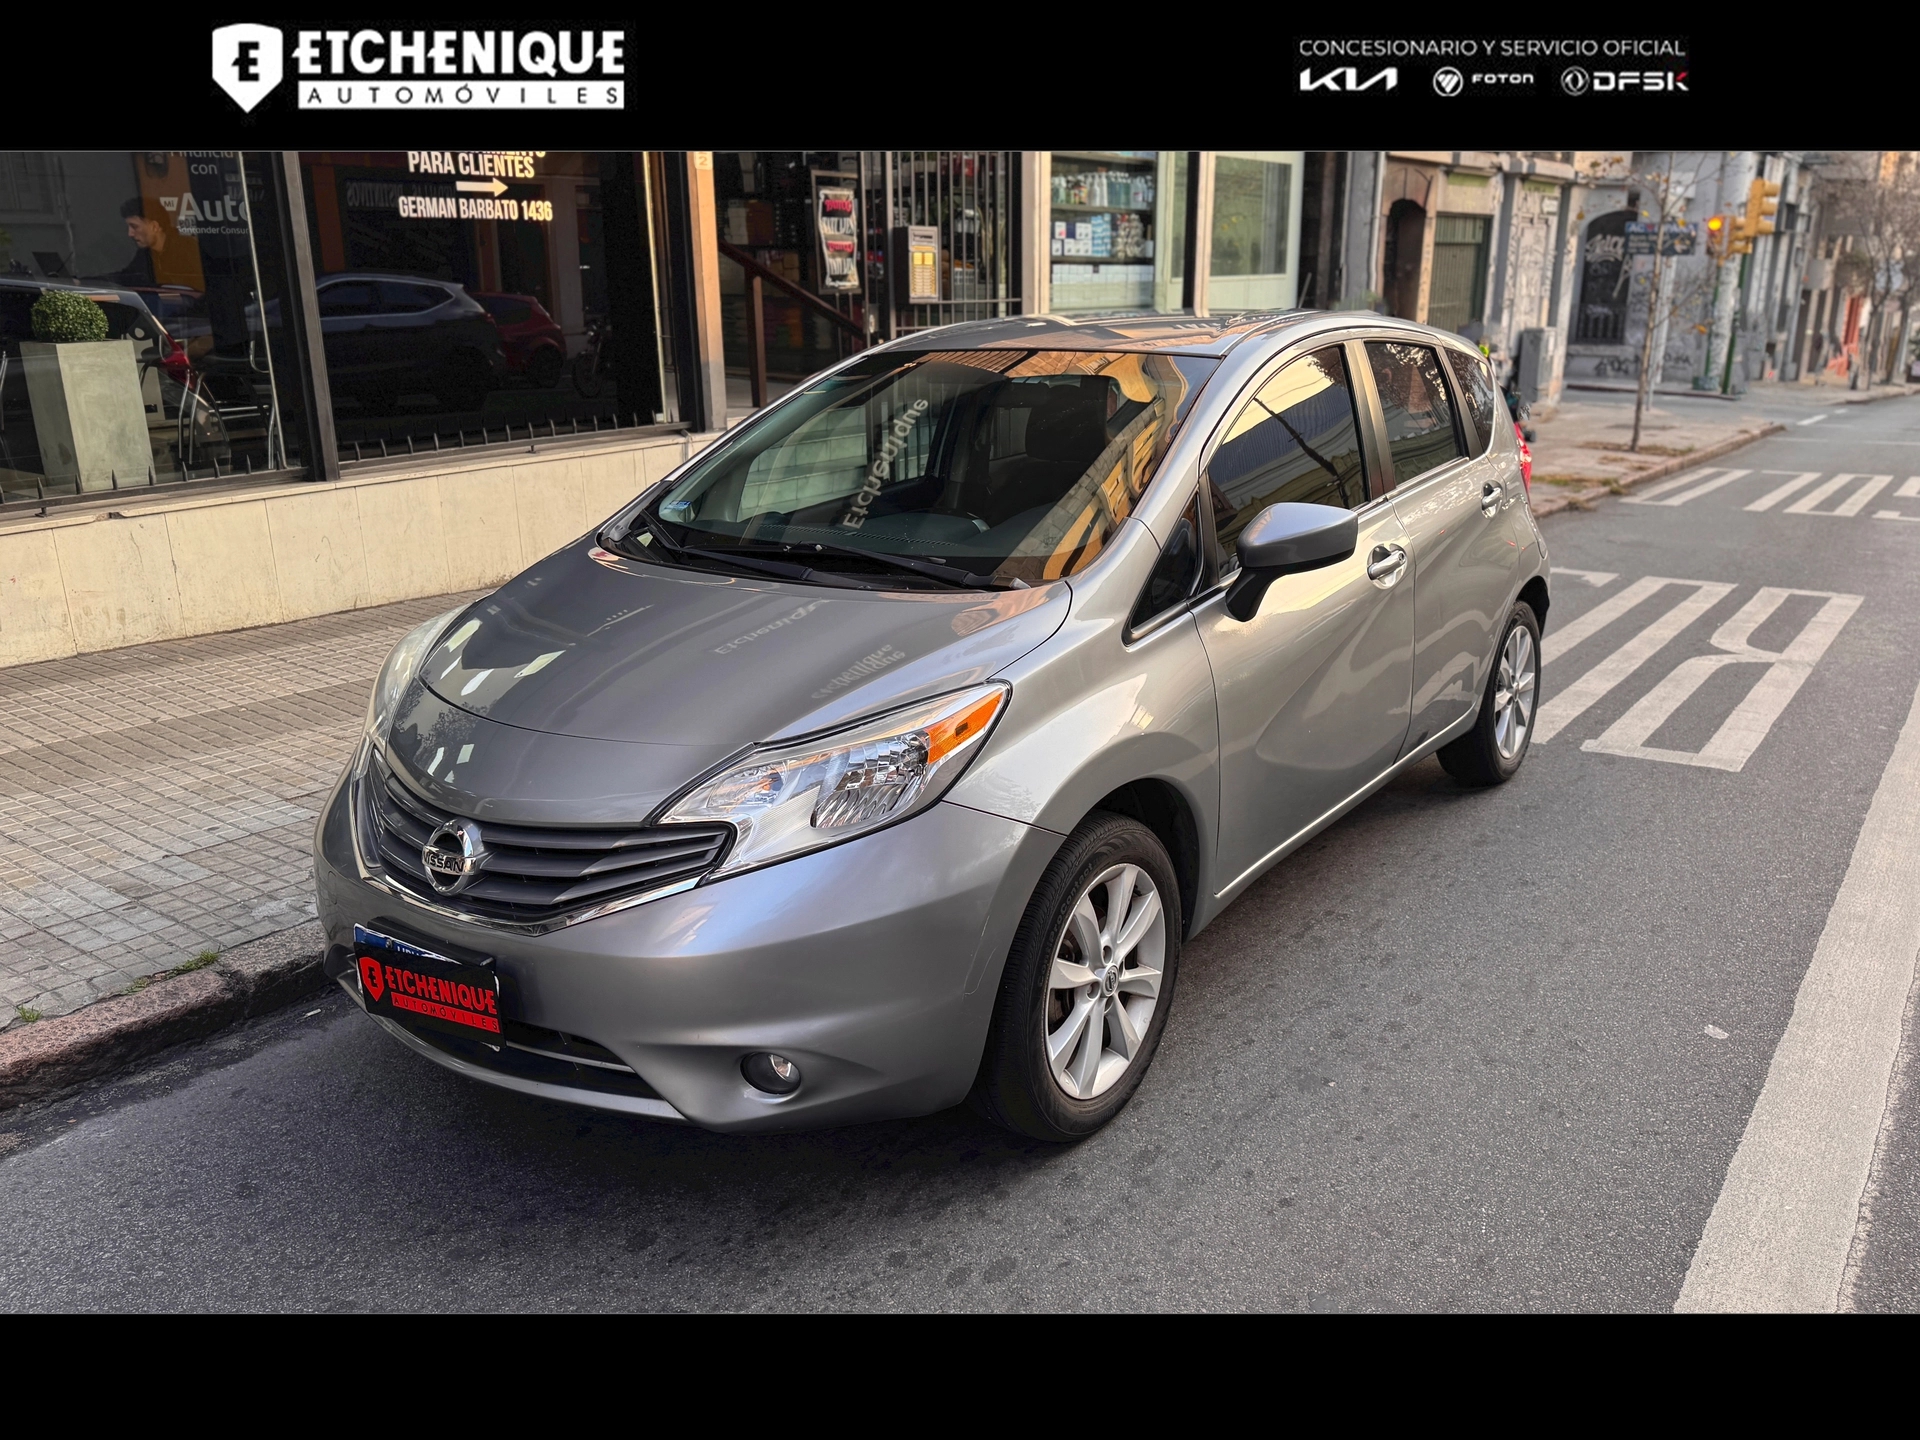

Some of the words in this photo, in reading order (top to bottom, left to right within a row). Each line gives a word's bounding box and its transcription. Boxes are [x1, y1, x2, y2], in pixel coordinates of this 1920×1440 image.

[190, 163, 218, 175] con
[407, 151, 456, 174] PARA
[458, 153, 535, 179] CLIENTES
[398, 196, 458, 219] GERMAN
[459, 198, 519, 221] BARBATO
[521, 200, 554, 222] 1436
[177, 225, 220, 235] Santander
[424, 850, 465, 874] NISSAN
[385, 966, 498, 1015] ETCHENIQUE
[393, 995, 499, 1030] AUTOMÓVILES
